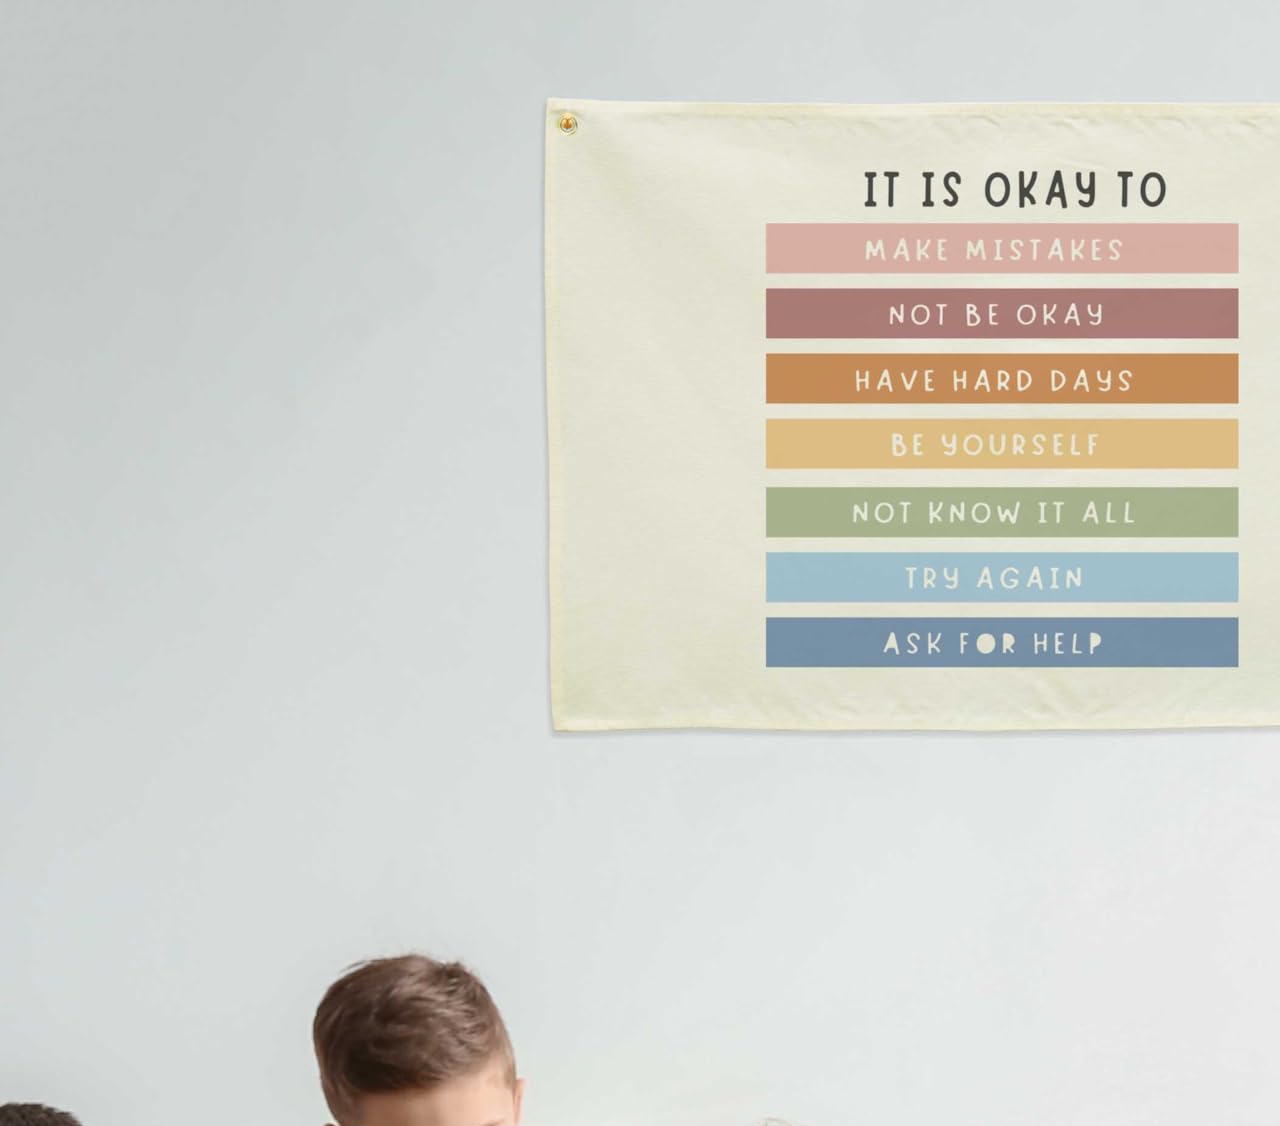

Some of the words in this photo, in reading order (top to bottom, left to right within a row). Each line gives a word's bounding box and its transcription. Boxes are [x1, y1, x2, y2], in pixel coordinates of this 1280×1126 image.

[864, 171, 900, 208] IT
[921, 170, 962, 208] IS
[984, 169, 1096, 209] OKAY
[1116, 170, 1167, 208] TO
[865, 237, 948, 262] MAKE
[965, 237, 1123, 262] MISTAKES
[889, 303, 948, 326] NOT
[966, 303, 999, 327] BE
[1016, 302, 1102, 327] OKAY
[855, 368, 935, 393] HAVE
[953, 368, 1033, 393] HARD
[1050, 368, 1133, 393] DAYS
[891, 432, 924, 457] BE
[940, 432, 1098, 457] YOURSELF
[852, 501, 912, 524] NOT
[928, 501, 1021, 525] KNOW
[1038, 501, 1065, 524] IT
[1082, 500, 1135, 525] ALL
[905, 566, 959, 590] TRY
[976, 565, 1082, 590] AGAIN
[883, 631, 942, 656] ASK
[959, 632, 1016, 655] FOR
[1033, 632, 1102, 655] HELP
